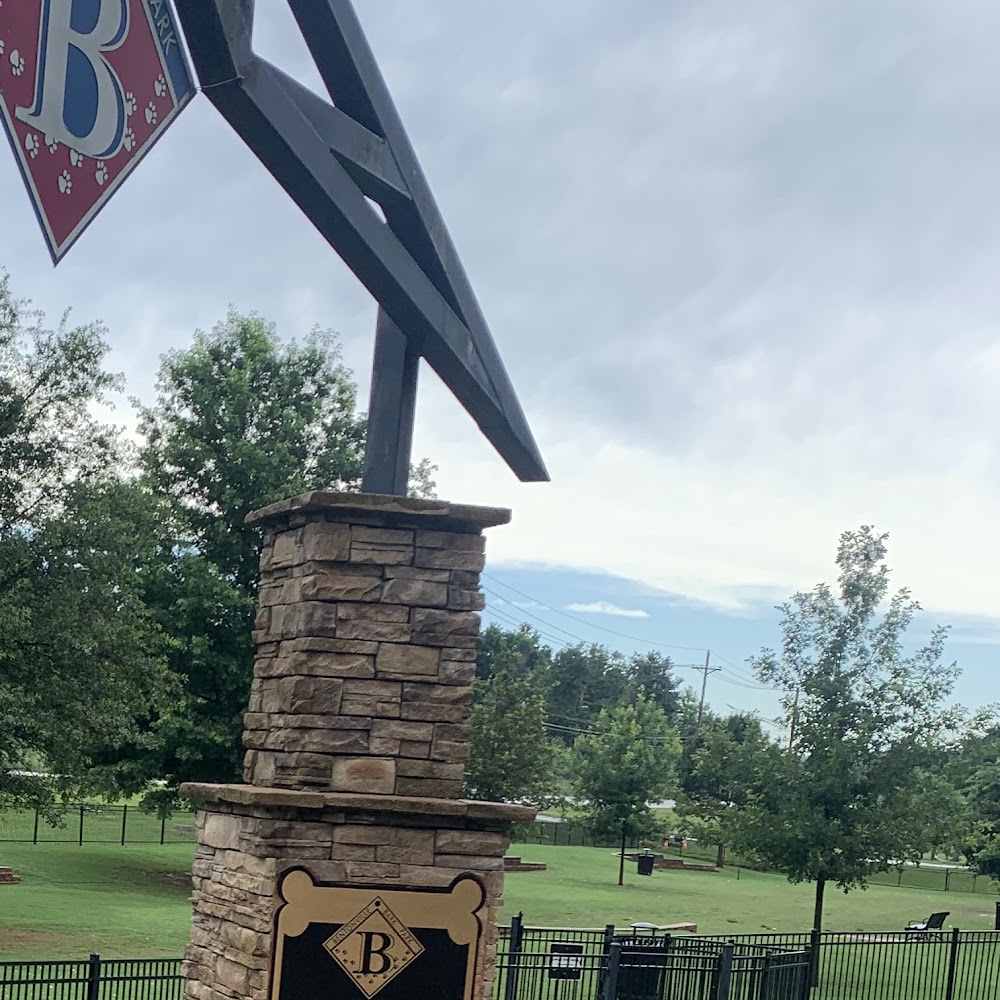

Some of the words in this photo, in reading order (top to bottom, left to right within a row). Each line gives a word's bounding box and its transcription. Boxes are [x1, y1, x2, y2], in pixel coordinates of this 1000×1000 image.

[150, 0, 177, 56] ARK
[15, 0, 130, 160] B
[332, 908, 371, 944] BENTONVILLE
[383, 909, 397, 925] BARK
[399, 928, 413, 944] PARK
[353, 932, 395, 974] B
